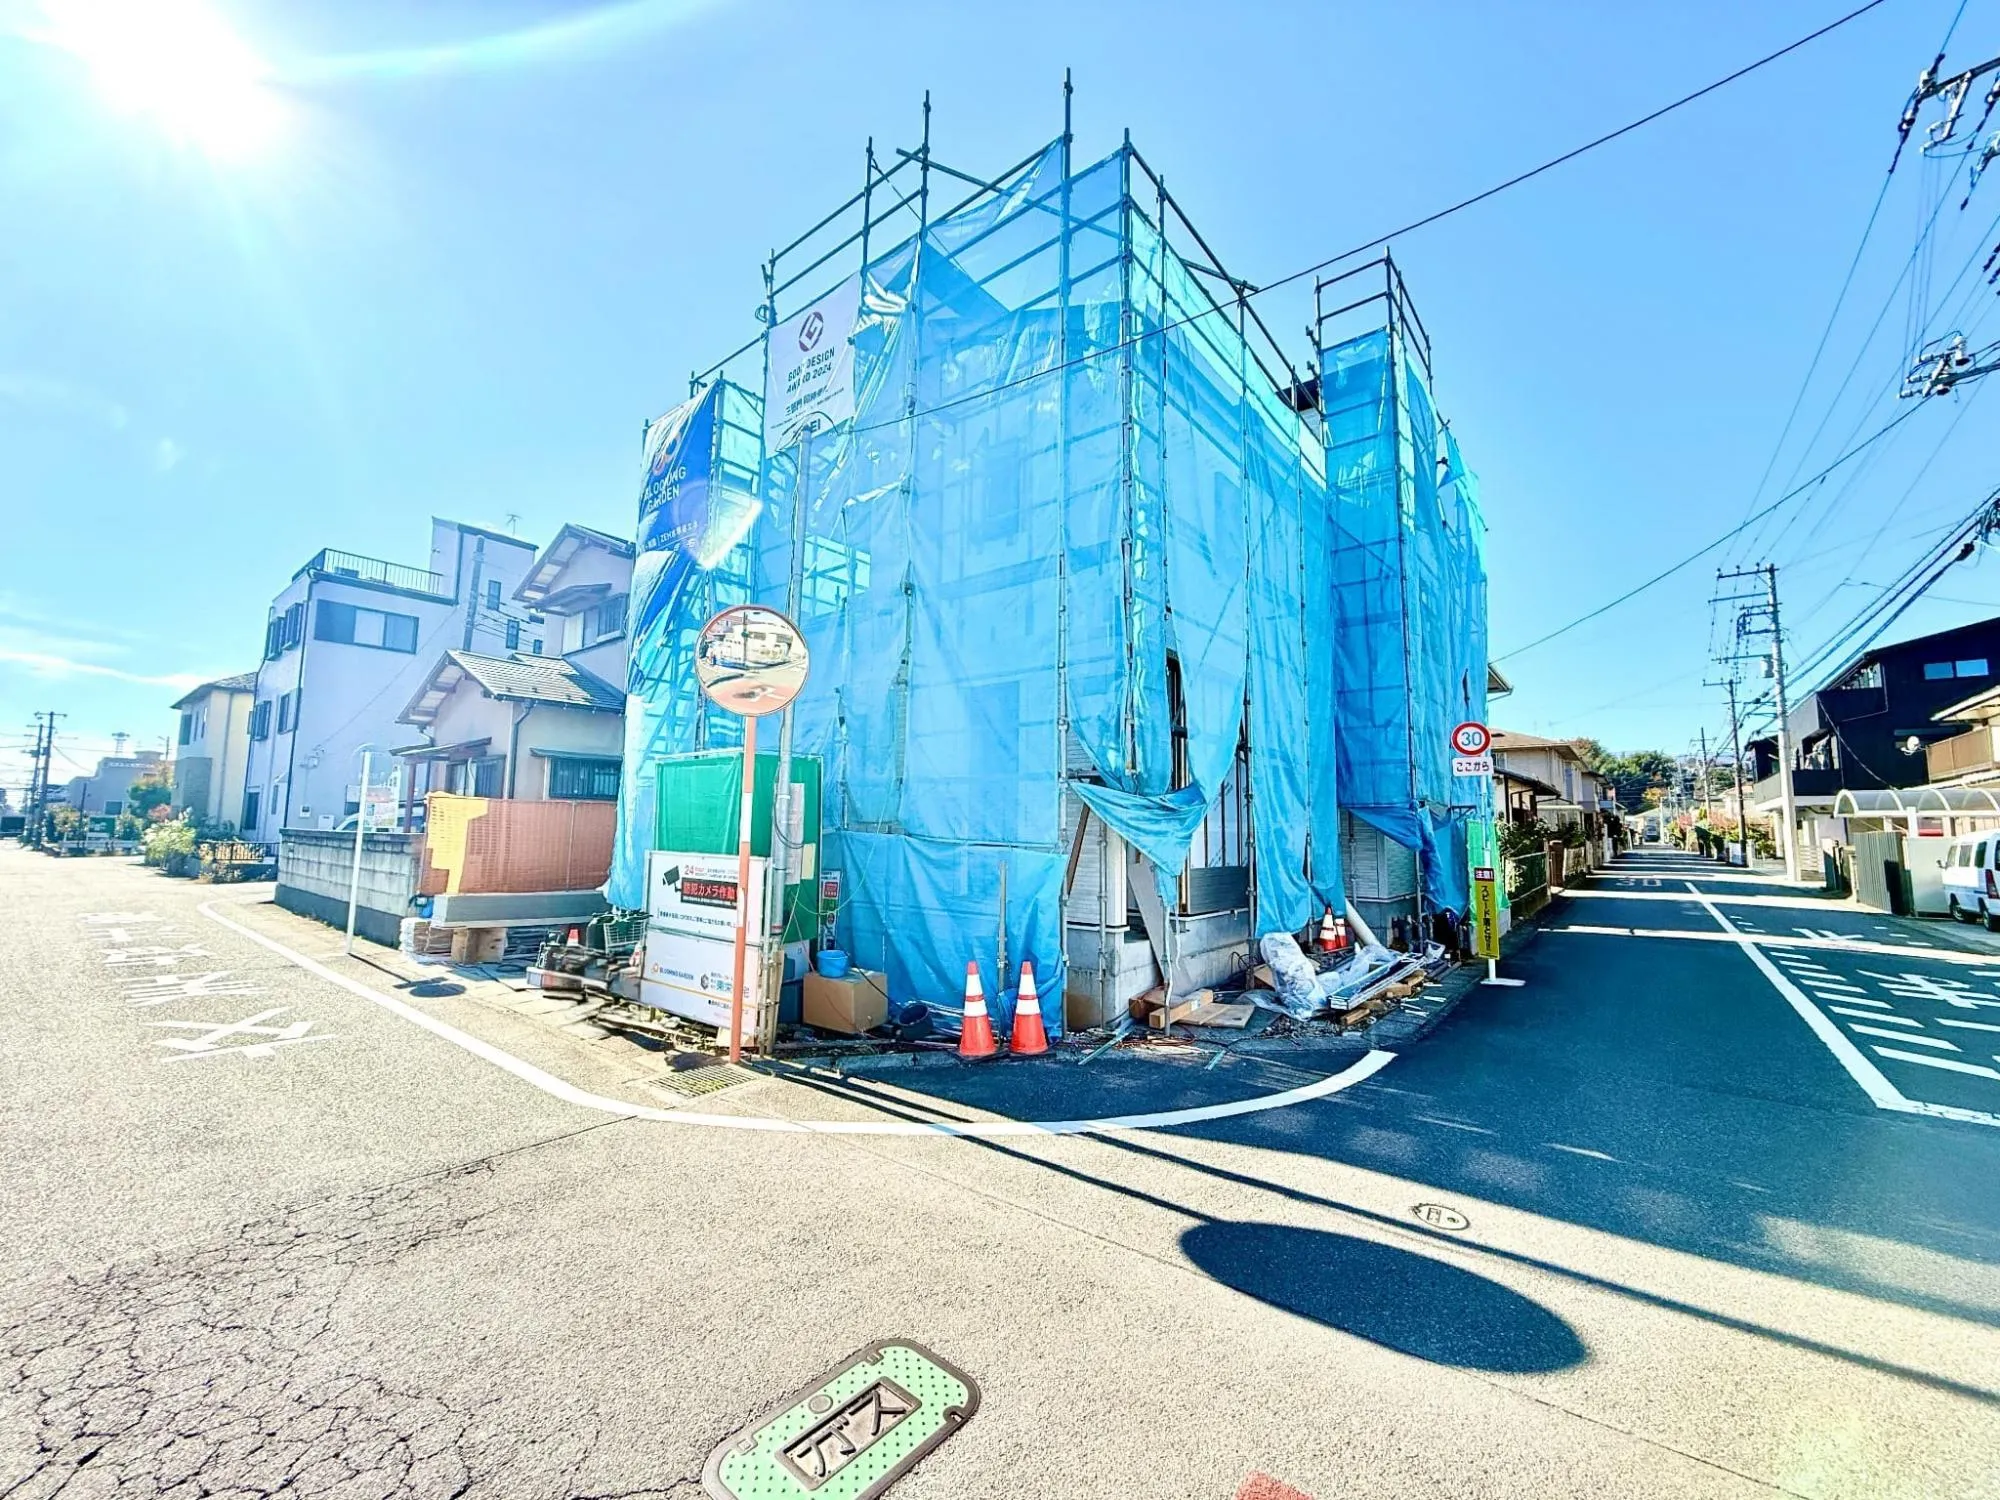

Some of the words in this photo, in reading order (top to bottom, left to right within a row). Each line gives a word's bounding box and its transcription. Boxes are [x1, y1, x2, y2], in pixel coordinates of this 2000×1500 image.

[786, 370, 811, 393] AWAD
[812, 362, 833, 380] 2024
[788, 360, 805, 382] GOO
[1461, 731, 1482, 746] 30
[1456, 761, 1489, 772] ここから
[684, 864, 695, 875] 24
[683, 881, 735, 900] 防犯カメラ作動
[1616, 877, 1662, 887] 30
[796, 1389, 907, 1478] ガス
